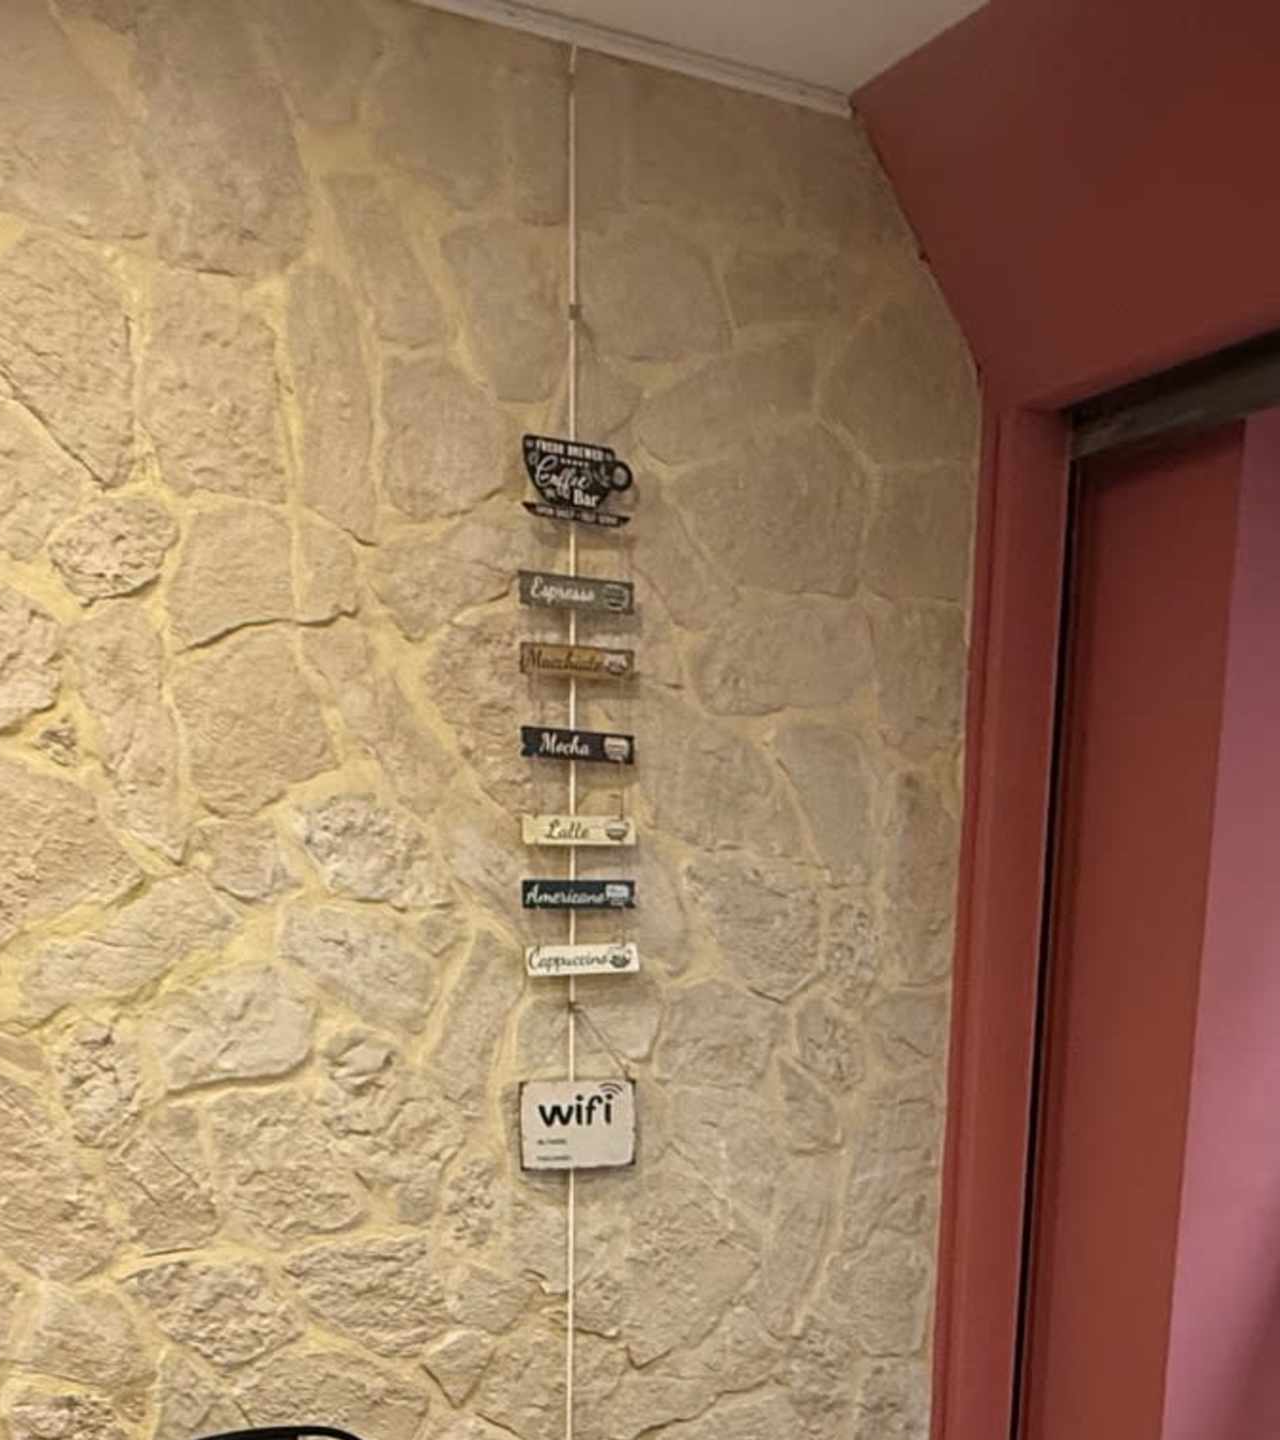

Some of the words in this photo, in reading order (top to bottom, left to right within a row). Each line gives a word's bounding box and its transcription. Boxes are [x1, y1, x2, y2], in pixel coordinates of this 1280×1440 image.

[535, 454, 591, 499] Coffee
[573, 488, 601, 508] Bar
[530, 575, 595, 605] Espresso
[538, 732, 590, 757] Mocha
[543, 818, 590, 840] Latte
[525, 882, 605, 905] Americano
[528, 944, 608, 973] Cappuccino
[537, 1093, 614, 1128] wifi
